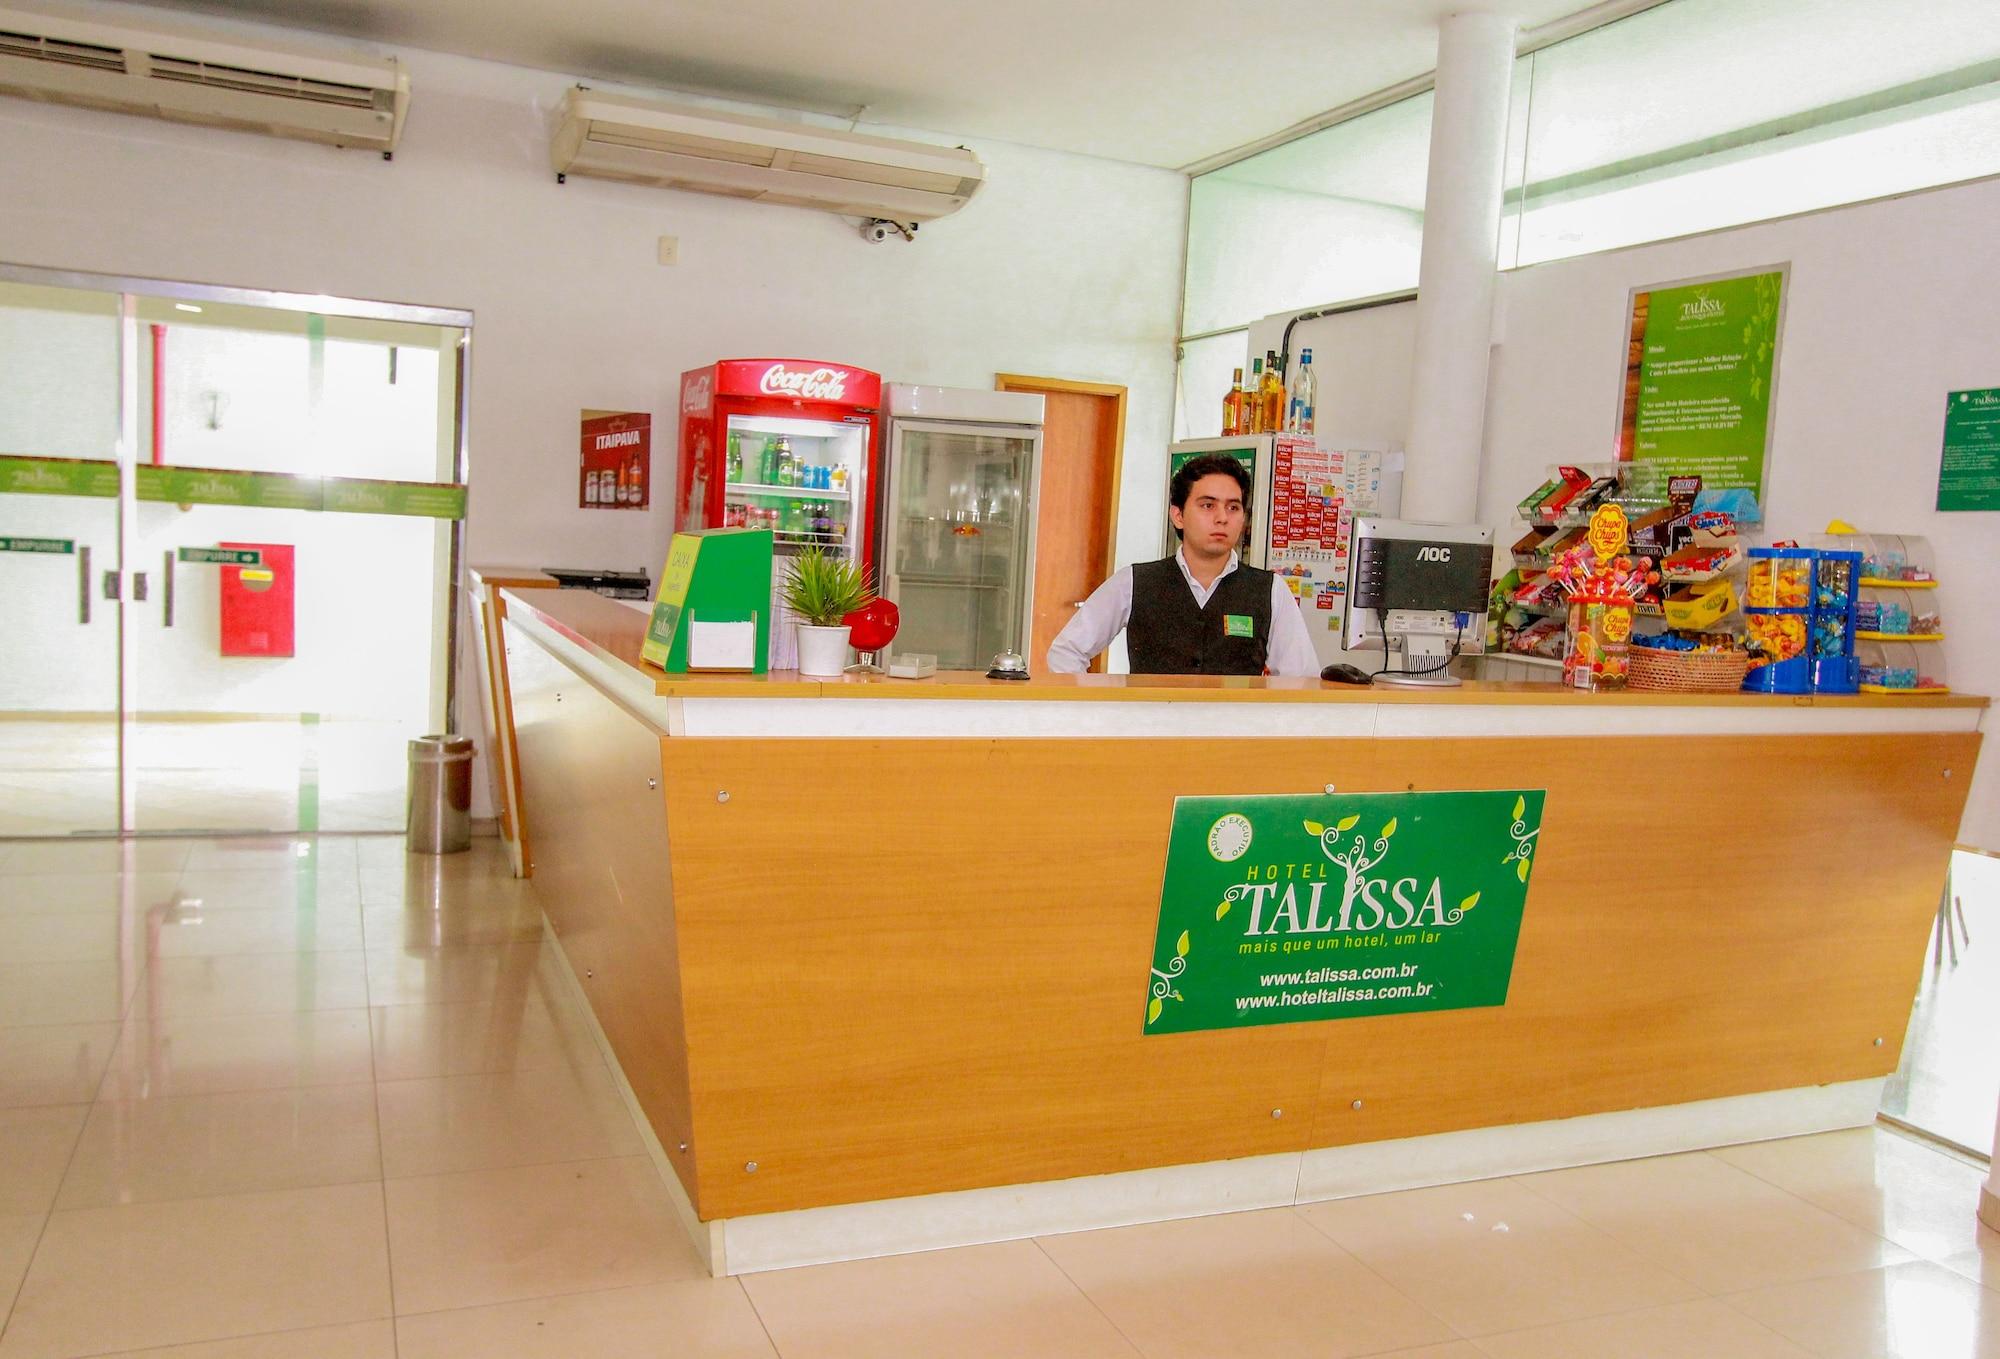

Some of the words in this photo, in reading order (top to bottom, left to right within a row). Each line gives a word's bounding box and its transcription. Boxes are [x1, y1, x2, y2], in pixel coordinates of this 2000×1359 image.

[1683, 297, 1721, 315] TALISSA
[760, 364, 849, 400] Coca-Cola
[595, 430, 641, 450] ITAIPAVA
[1594, 529, 1620, 542] Chups
[1596, 518, 1621, 531] Chupa
[1416, 546, 1451, 563] AOC
[1211, 820, 1226, 856] PADRÃO
[1229, 817, 1250, 856] EXECUTIVO
[1247, 863, 1327, 880] HOTEL
[1226, 876, 1462, 936] TALISSA
[1239, 939, 1277, 954] mais
[1283, 940, 1311, 954] que
[1317, 938, 1339, 949] um
[1344, 933, 1388, 948] hotel,
[1394, 934, 1416, 945] um
[1421, 930, 1441, 944] lar
[1260, 962, 1418, 987] www.talissa.com.br
[1235, 981, 1433, 1010] www.hoteltalissa.com.br
